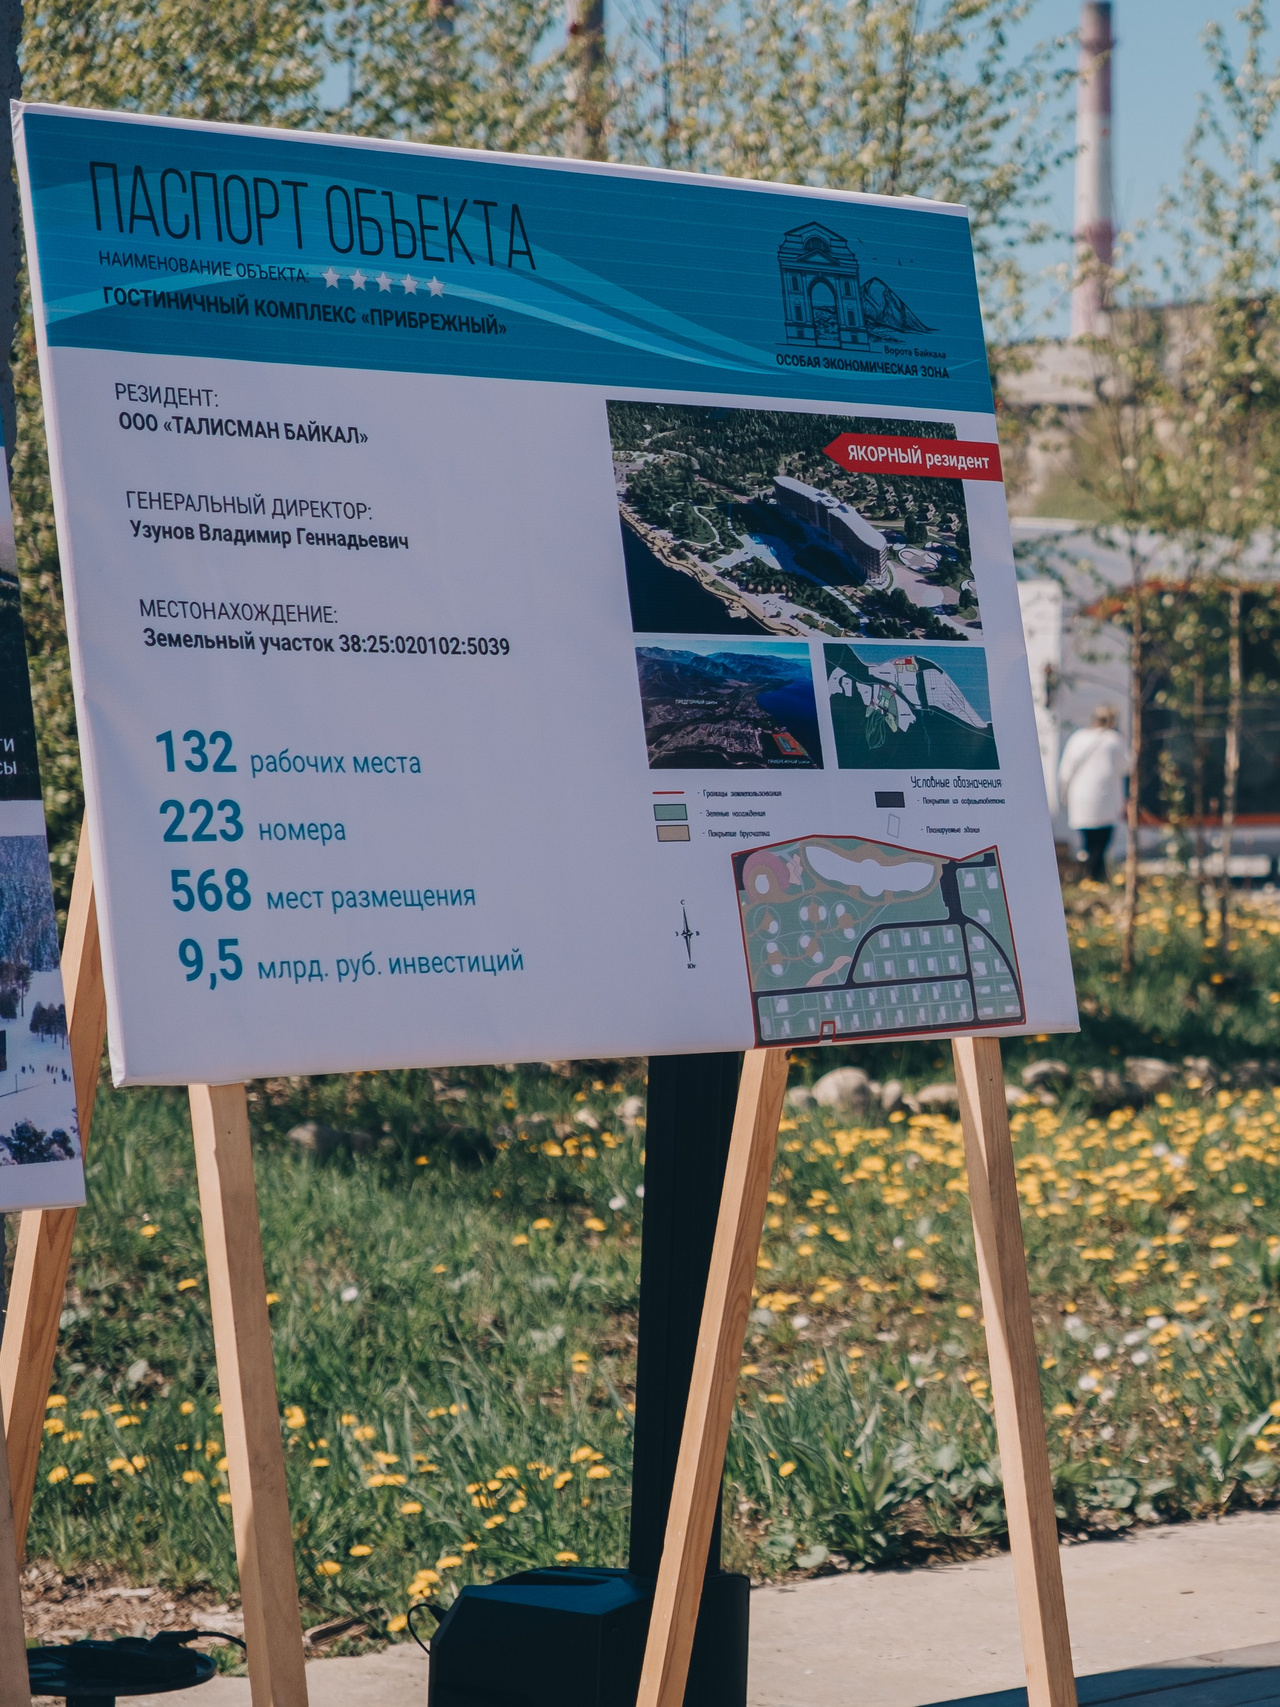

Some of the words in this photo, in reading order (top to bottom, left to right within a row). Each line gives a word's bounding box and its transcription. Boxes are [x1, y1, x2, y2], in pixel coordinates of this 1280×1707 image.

[89, 160, 308, 250] ПАСПОРТ
[325, 185, 536, 270] ОБЪЕКТА
[99, 250, 232, 278] НАИМЕНОВАНИЕ
[236, 262, 309, 283] ОБЪЕКТА:
[103, 286, 248, 316] ГОСТИНИЧНЫЙ
[254, 299, 356, 324] КОМПЛЕКС
[361, 307, 507, 336] «ПРИБРЕЖНЫЙ»
[776, 353, 821, 368] ОСОБАЯ
[822, 357, 918, 376] ЭКОНОМИЧЕСКАЯ
[920, 365, 950, 378] ЗОНА
[884, 345, 912, 357] Ворота
[914, 348, 946, 359] Байкала
[115, 383, 218, 408] РЕЗИДЕНТ:
[119, 412, 158, 431] ООО
[164, 416, 279, 439] «ТАЛИСМАН
[284, 421, 368, 443] БАЙКАЛ»
[848, 445, 922, 464] ЯКОРНЫЙ
[926, 454, 989, 470] резидент
[126, 491, 265, 514] ГЕНЕРАЛЬНЫЙ
[272, 499, 372, 520] ДИРЕКТОР:
[130, 520, 195, 543] Узунов
[199, 524, 291, 548] Владимир
[297, 528, 408, 550] Геннадьевич
[140, 599, 337, 625] МЕСТОНАХОЖДЕНИЕ:
[143, 628, 255, 649] Земельный
[259, 637, 334, 655] участок
[339, 634, 509, 655] 38:25:020102:5039
[156, 730, 236, 772] 132
[251, 748, 345, 778] рабочих
[353, 756, 421, 773] места
[160, 799, 243, 842] 223
[259, 823, 345, 846] номера
[171, 868, 251, 912] 568
[267, 891, 323, 909] мест
[332, 889, 475, 914] размещения
[179, 939, 242, 990] 9,5
[258, 960, 328, 984] млрд.
[336, 951, 381, 982] руб.
[389, 949, 523, 976] инвестиций
